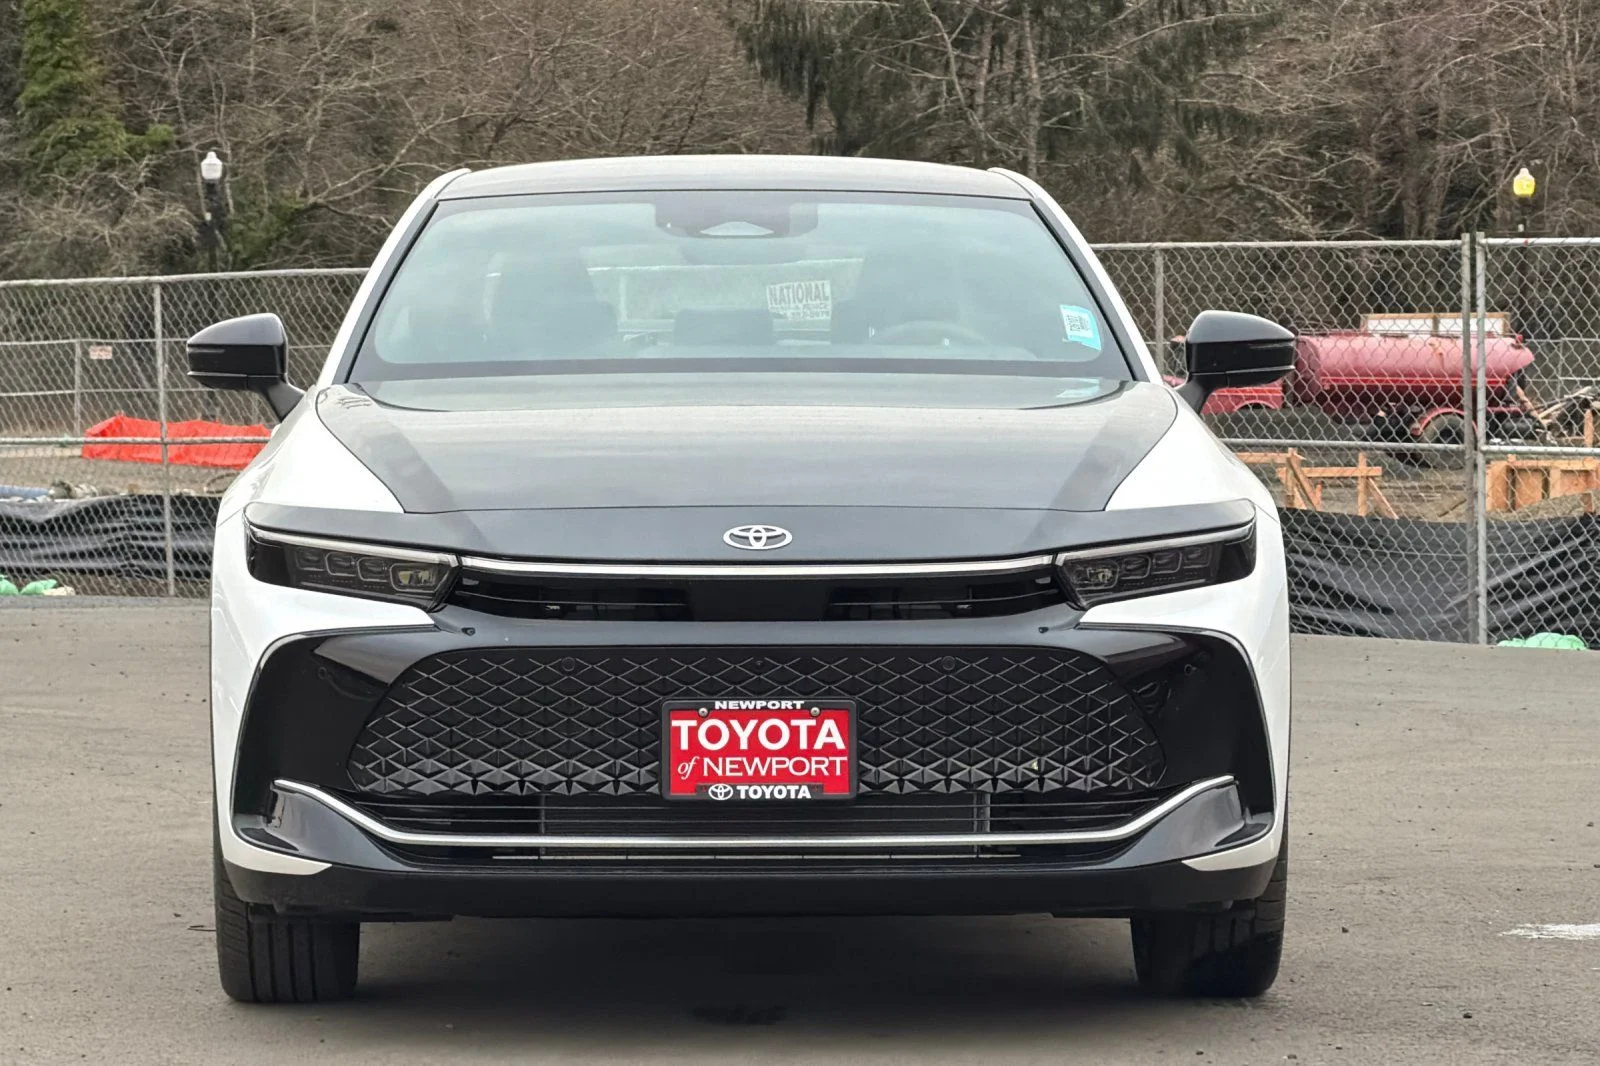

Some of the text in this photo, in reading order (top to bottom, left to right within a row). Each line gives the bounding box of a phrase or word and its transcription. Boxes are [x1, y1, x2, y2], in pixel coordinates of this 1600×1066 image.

[768, 282, 829, 306] NATIONAL
[714, 700, 805, 710] NEWPORT
[671, 718, 846, 751] TOYOTA
[677, 756, 848, 780] of NEWPORT
[736, 785, 812, 799] TOYOTA
